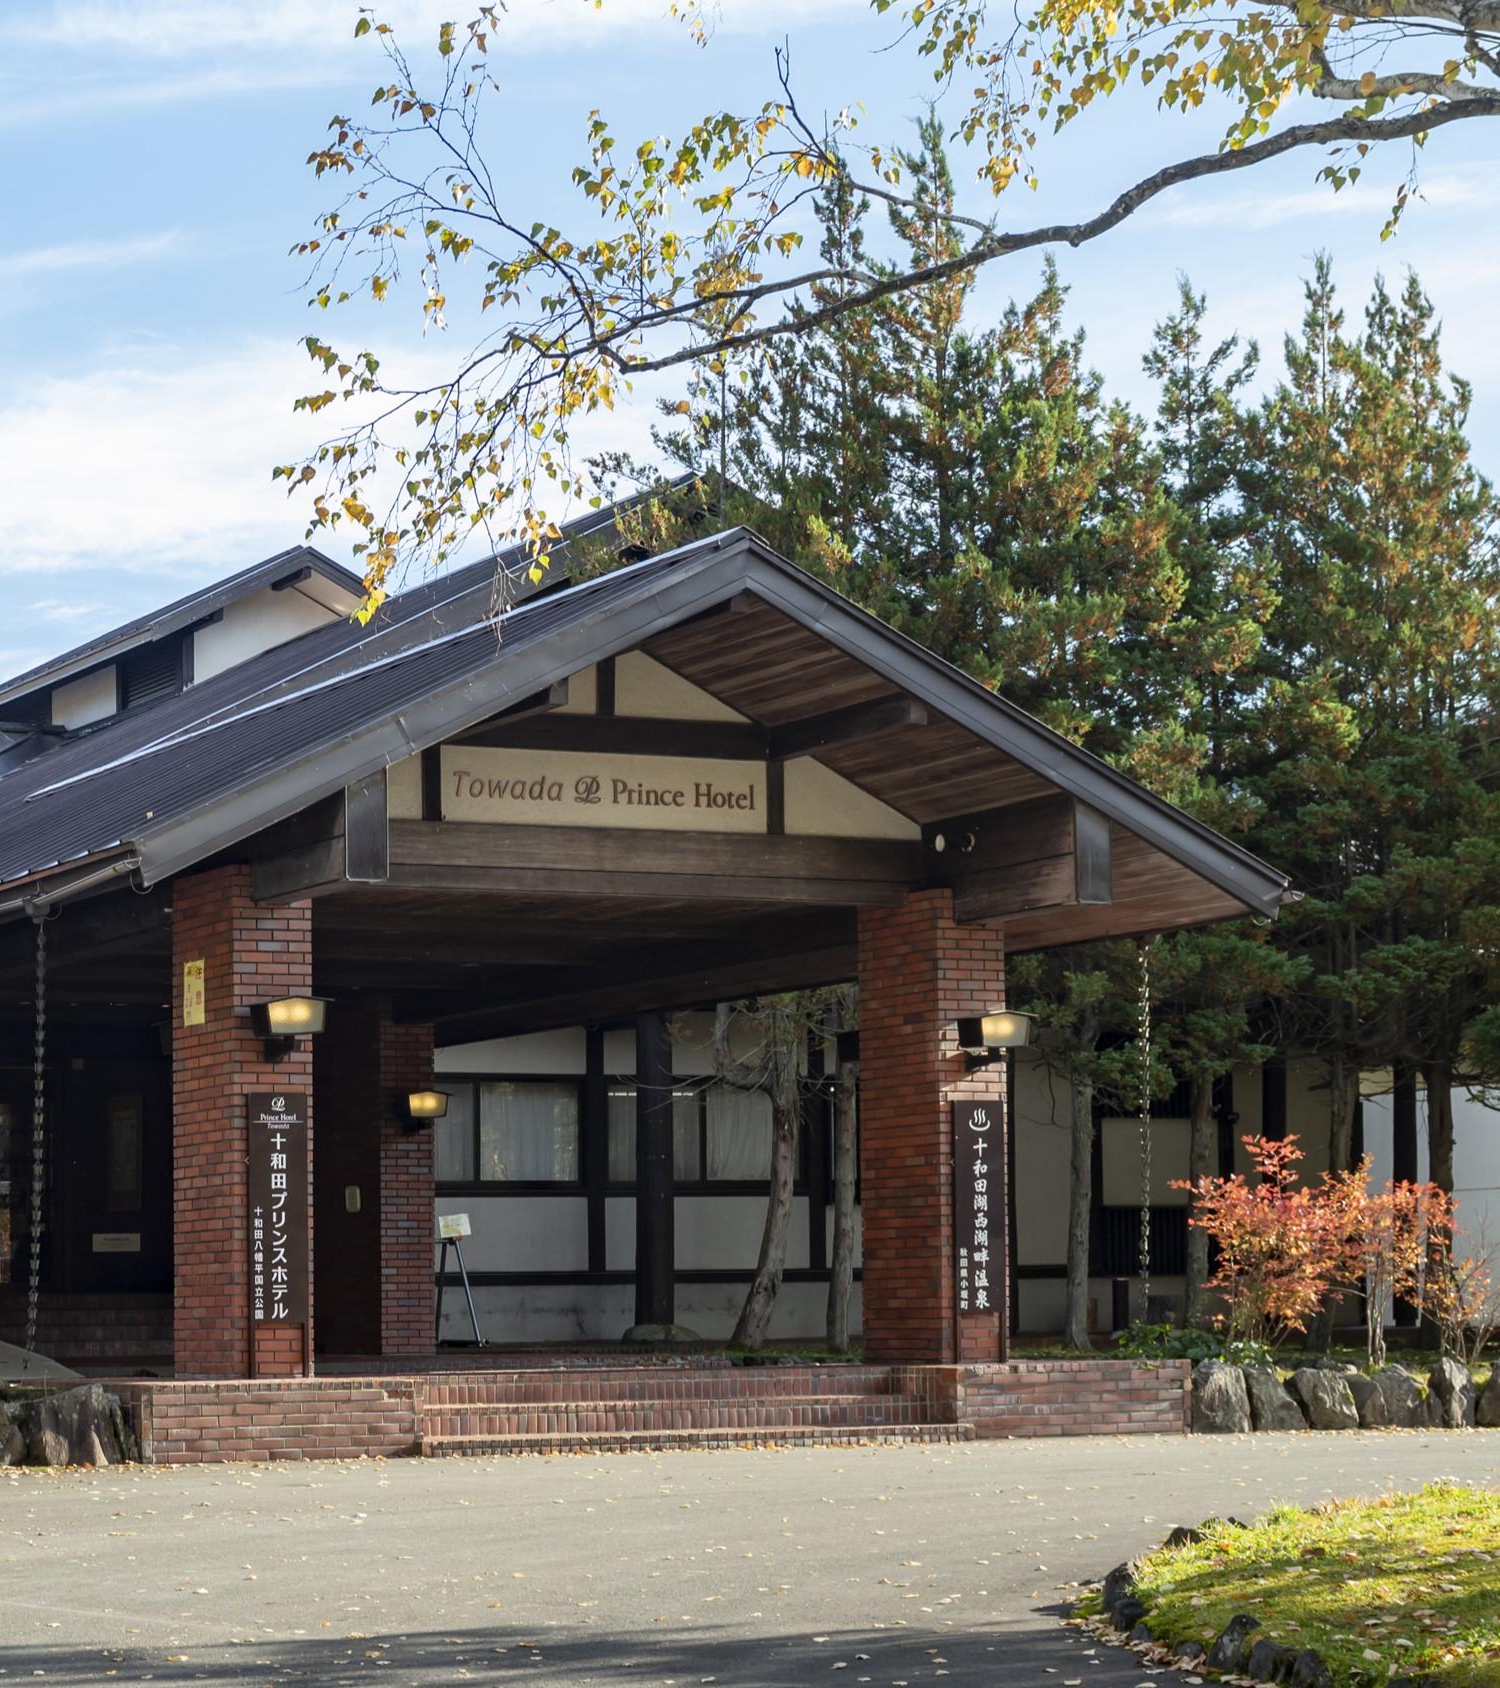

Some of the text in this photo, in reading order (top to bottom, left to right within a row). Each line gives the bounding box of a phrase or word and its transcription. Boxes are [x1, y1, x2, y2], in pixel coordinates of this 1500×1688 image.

[452, 770, 563, 802] Towada
[611, 779, 685, 807] Prince
[694, 783, 756, 810] Hotel
[260, 1113, 297, 1121] Prince Hotel
[253, 1205, 264, 1320] 十和田八幡平国立公園
[270, 1132, 289, 1320] 十和田プリンスホテル
[972, 1137, 990, 1309] 十和田湖西湖畔温泉
